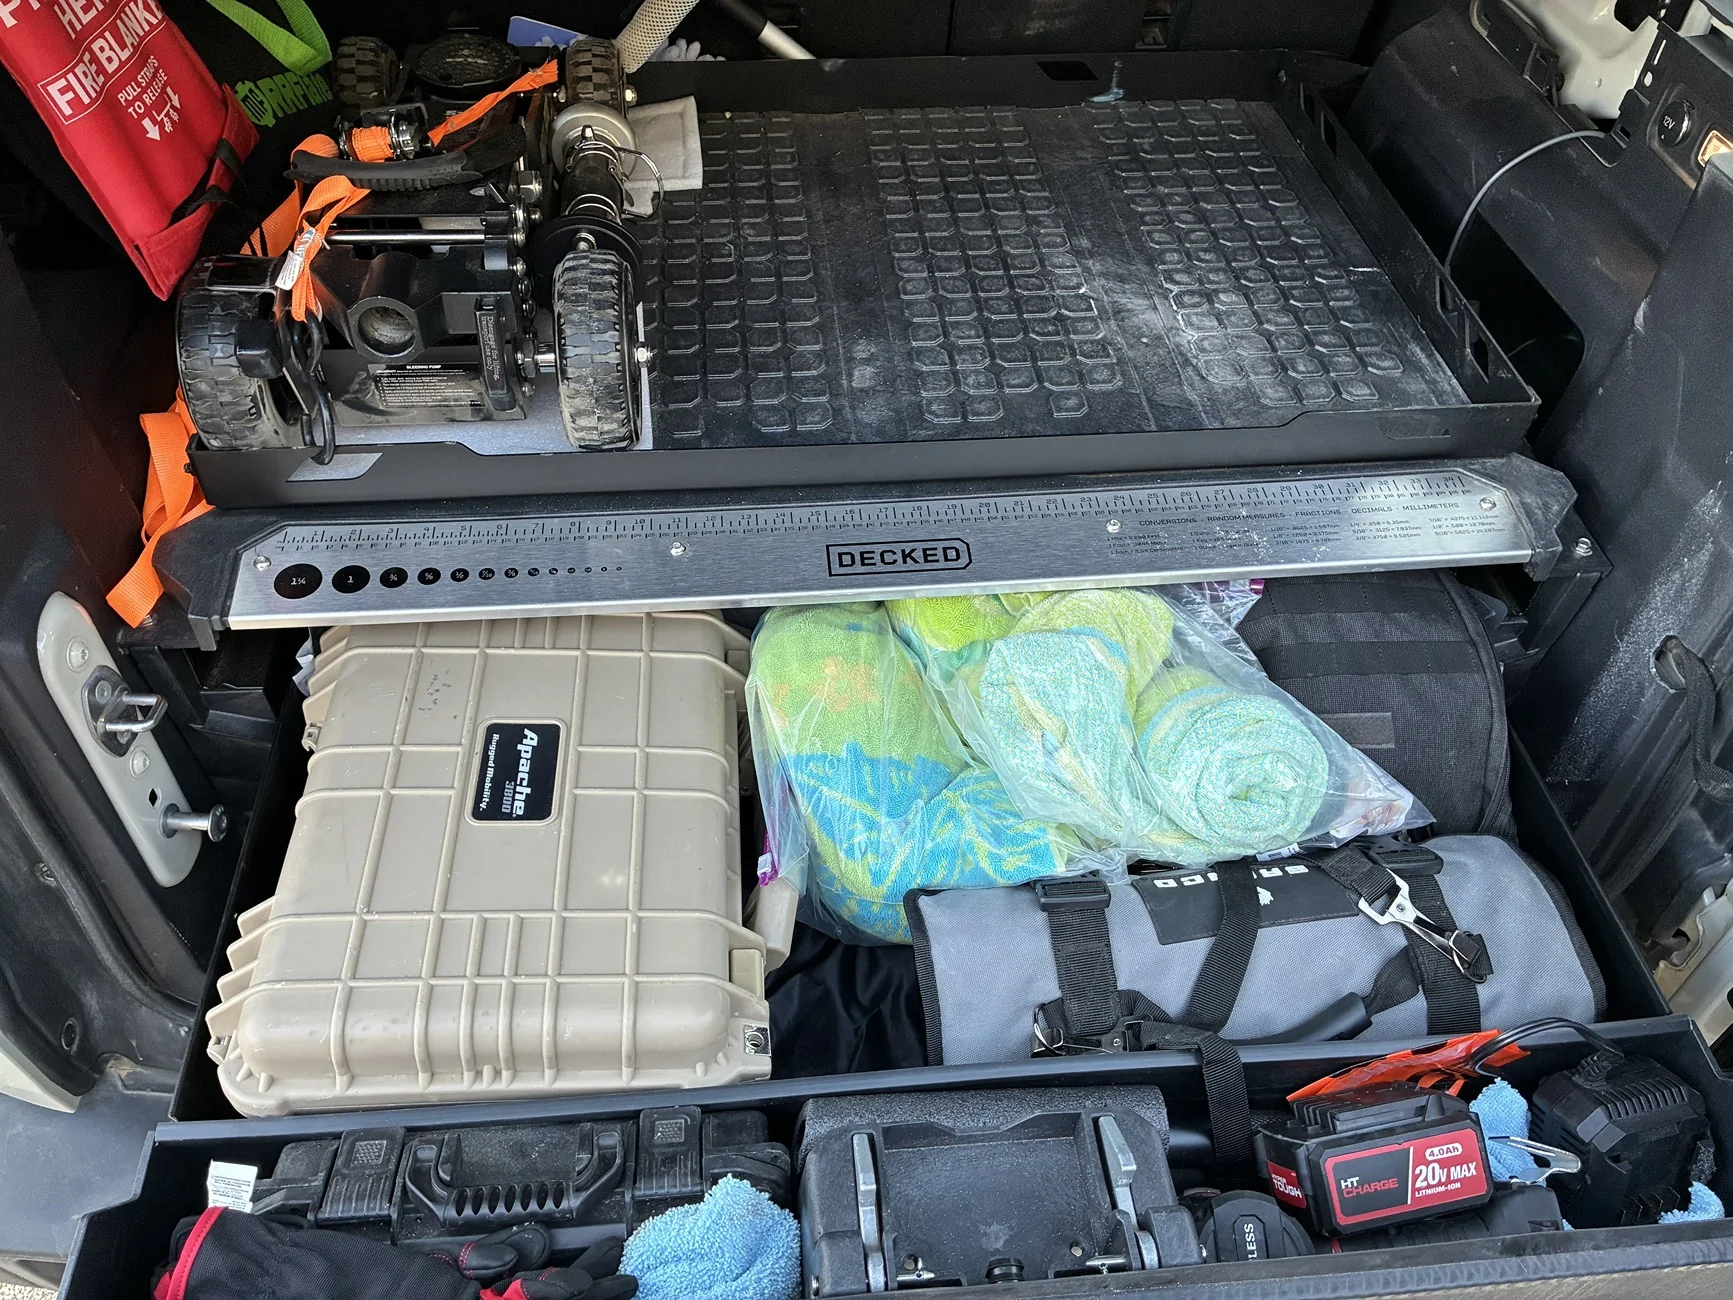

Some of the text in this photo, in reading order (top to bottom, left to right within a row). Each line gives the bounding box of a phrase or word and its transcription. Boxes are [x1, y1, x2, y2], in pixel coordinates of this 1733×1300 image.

[46, 52, 105, 116] FIRE
[91, 0, 163, 74] BLANKE
[118, 55, 158, 106] PULL STRAPS
[128, 68, 168, 118] TO RELEASE
[1663, 115, 1676, 130] 12V
[1139, 518, 1197, 526] CONVERSIONS
[1402, 502, 1459, 511] MILLIMETERS
[838, 546, 961, 568] DECKED
[502, 780, 515, 813] 3800
[1153, 865, 1309, 888] BRCO
[1429, 1146, 1459, 1158] 4.0Ah
[1450, 1162, 1477, 1180] MAX
[1273, 1179, 1302, 1198] TOUGH
[1340, 1176, 1359, 1189] HT
[1343, 1178, 1398, 1198] CHARGE
[1415, 1182, 1461, 1197] LITHIUM-ION
[1244, 1223, 1258, 1260] LESS
